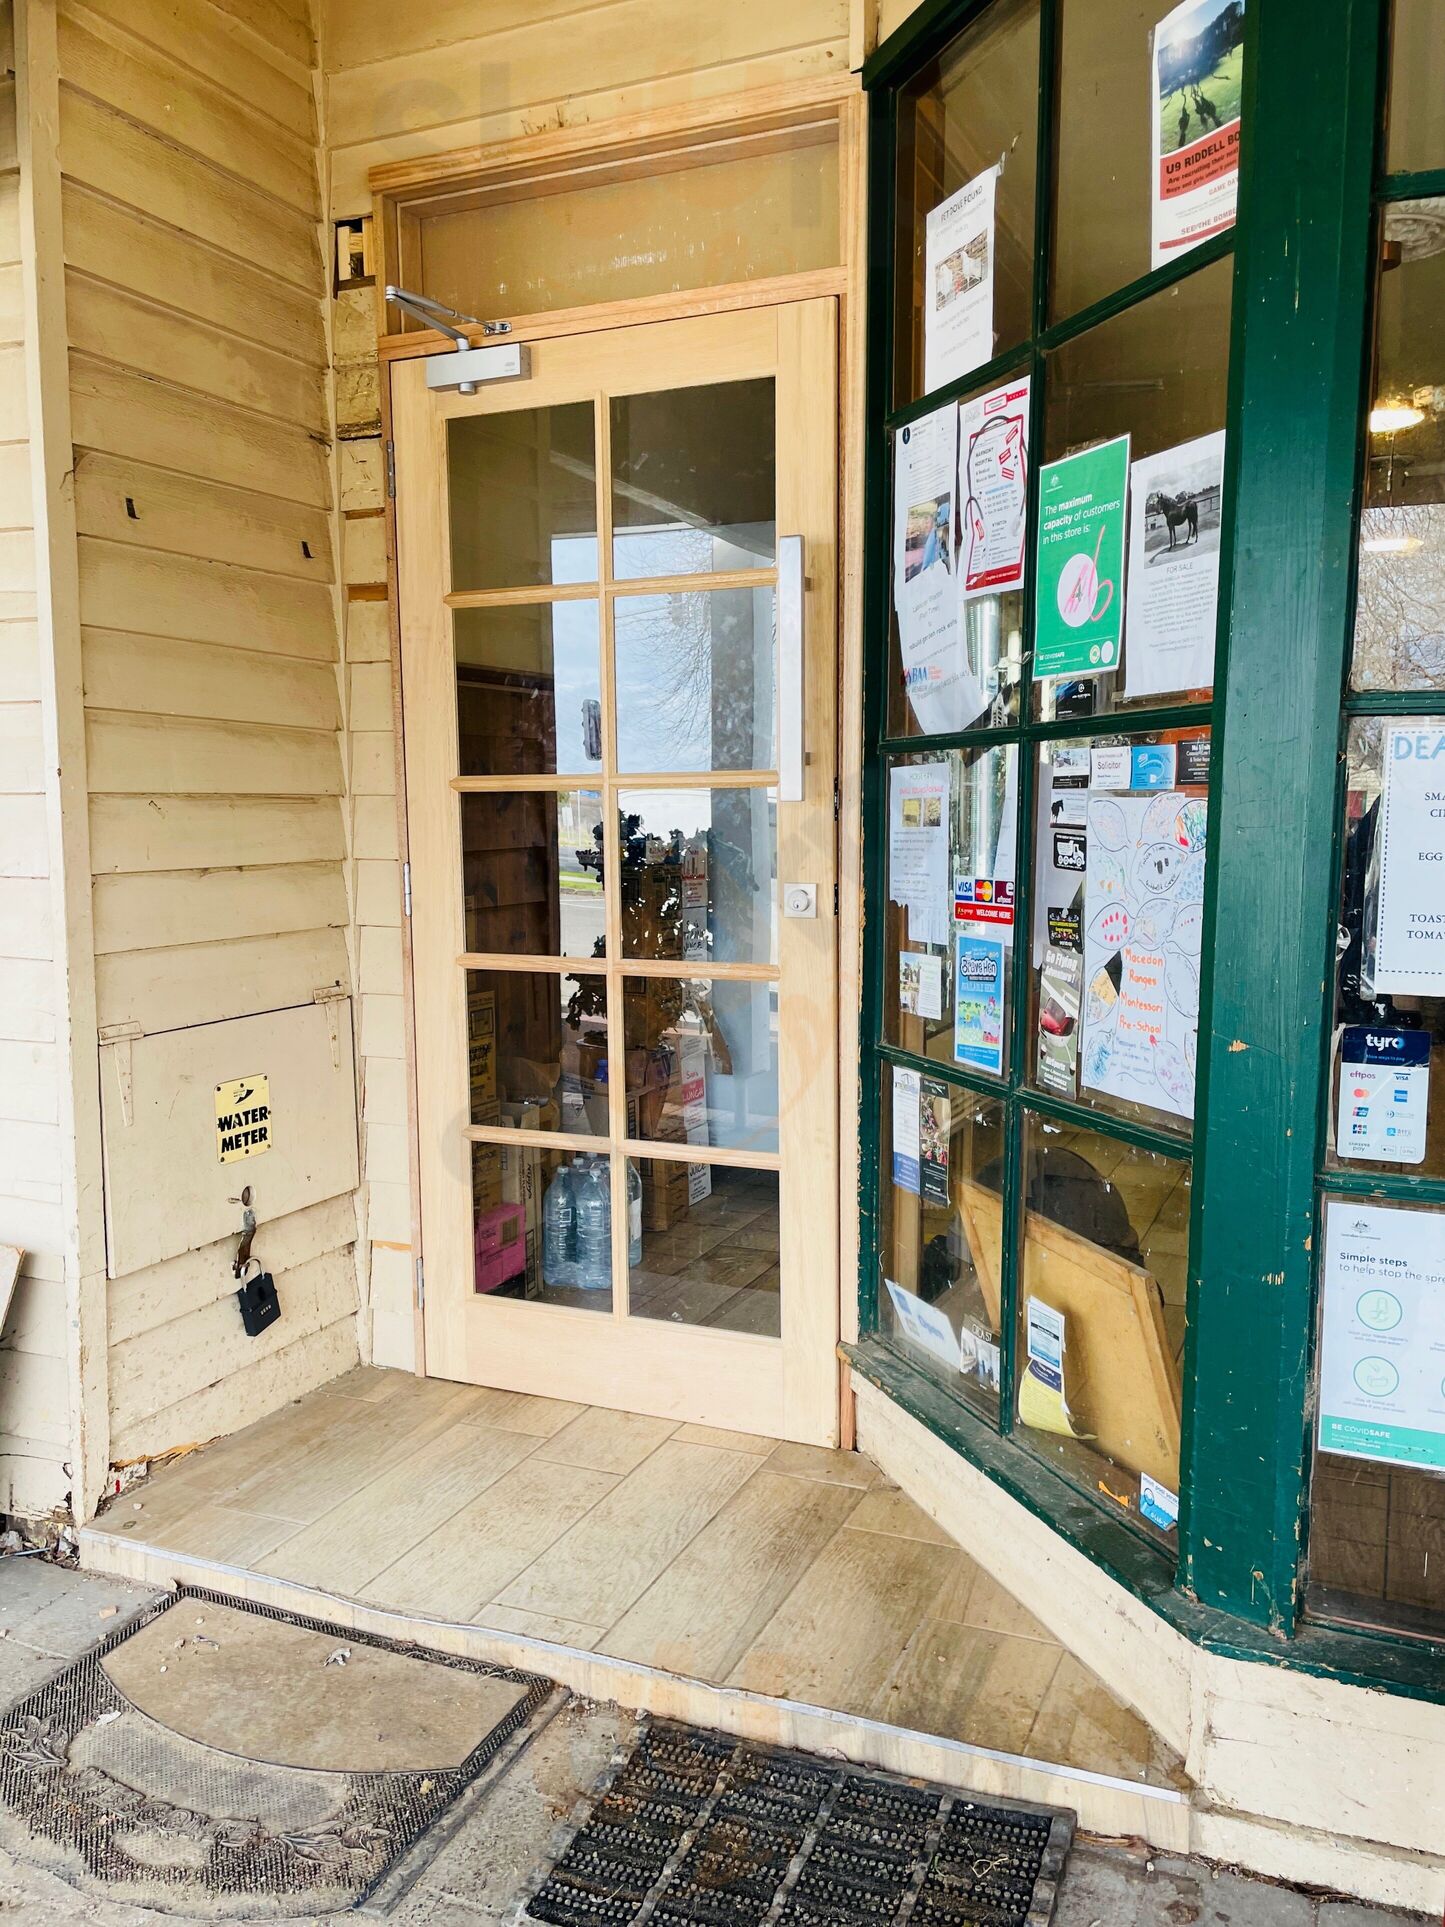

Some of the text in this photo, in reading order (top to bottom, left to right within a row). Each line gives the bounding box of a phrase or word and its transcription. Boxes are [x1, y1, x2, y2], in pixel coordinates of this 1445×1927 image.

[1166, 162, 1181, 174] U9
[1185, 141, 1225, 168] RIDDELL
[1045, 494, 1093, 516] The maximum
[1043, 499, 1121, 531] capacity of customers
[1042, 536, 1050, 545] in
[1050, 532, 1063, 543] this
[1063, 526, 1082, 539] store
[1166, 562, 1193, 574] FOR SALE
[1097, 761, 1121, 771] Solicitor
[1418, 852, 1443, 861] EGG
[958, 881, 972, 892] VISA
[976, 908, 1011, 919] WELCOME HERE
[1046, 950, 1078, 971] Go Flying
[1124, 948, 1163, 967] Macedon
[1128, 969, 1157, 990] Ranges
[1121, 991, 1163, 1013] Montessori
[1119, 1015, 1162, 1034] Pre-School
[1365, 1034, 1405, 1051] tyro
[1350, 1070, 1376, 1080] eftpos
[218, 1106, 268, 1132] WATER
[221, 1127, 268, 1154] METER
[1340, 1252, 1408, 1268] Simple steps
[1340, 1263, 1350, 1271] to
[1353, 1264, 1375, 1276] help
[1379, 1269, 1401, 1279] stop
[1405, 1271, 1422, 1280] the
[1344, 1424, 1391, 1438] COVIDSAFE
